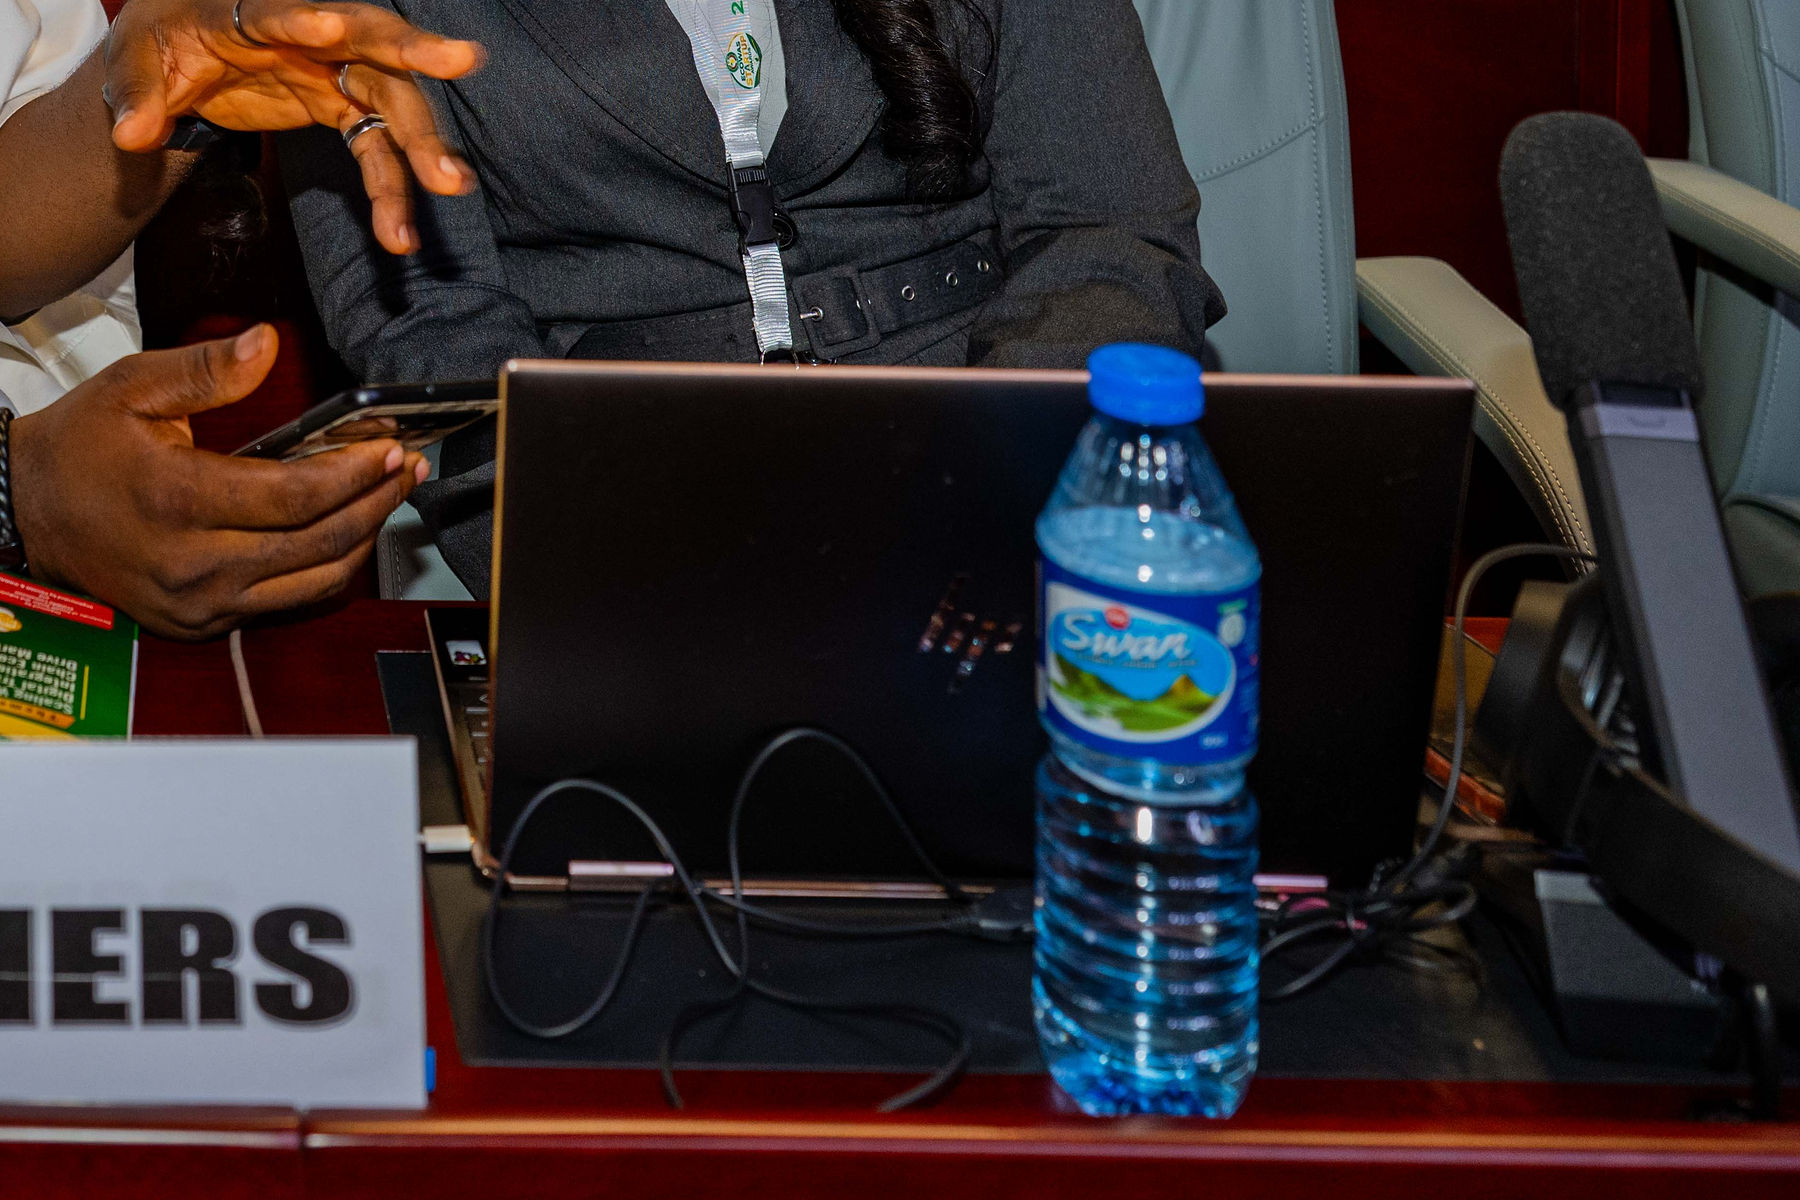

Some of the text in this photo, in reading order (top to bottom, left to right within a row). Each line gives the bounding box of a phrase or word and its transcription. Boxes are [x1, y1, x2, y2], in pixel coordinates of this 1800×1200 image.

[735, 41, 747, 81] ECOWAS
[739, 35, 753, 86] STARTUP
[1061, 612, 1190, 660] Swan
[31, 662, 76, 682] Chain
[36, 652, 78, 671] Drive
[14, 688, 73, 715] Scaling
[21, 680, 74, 703] Digital
